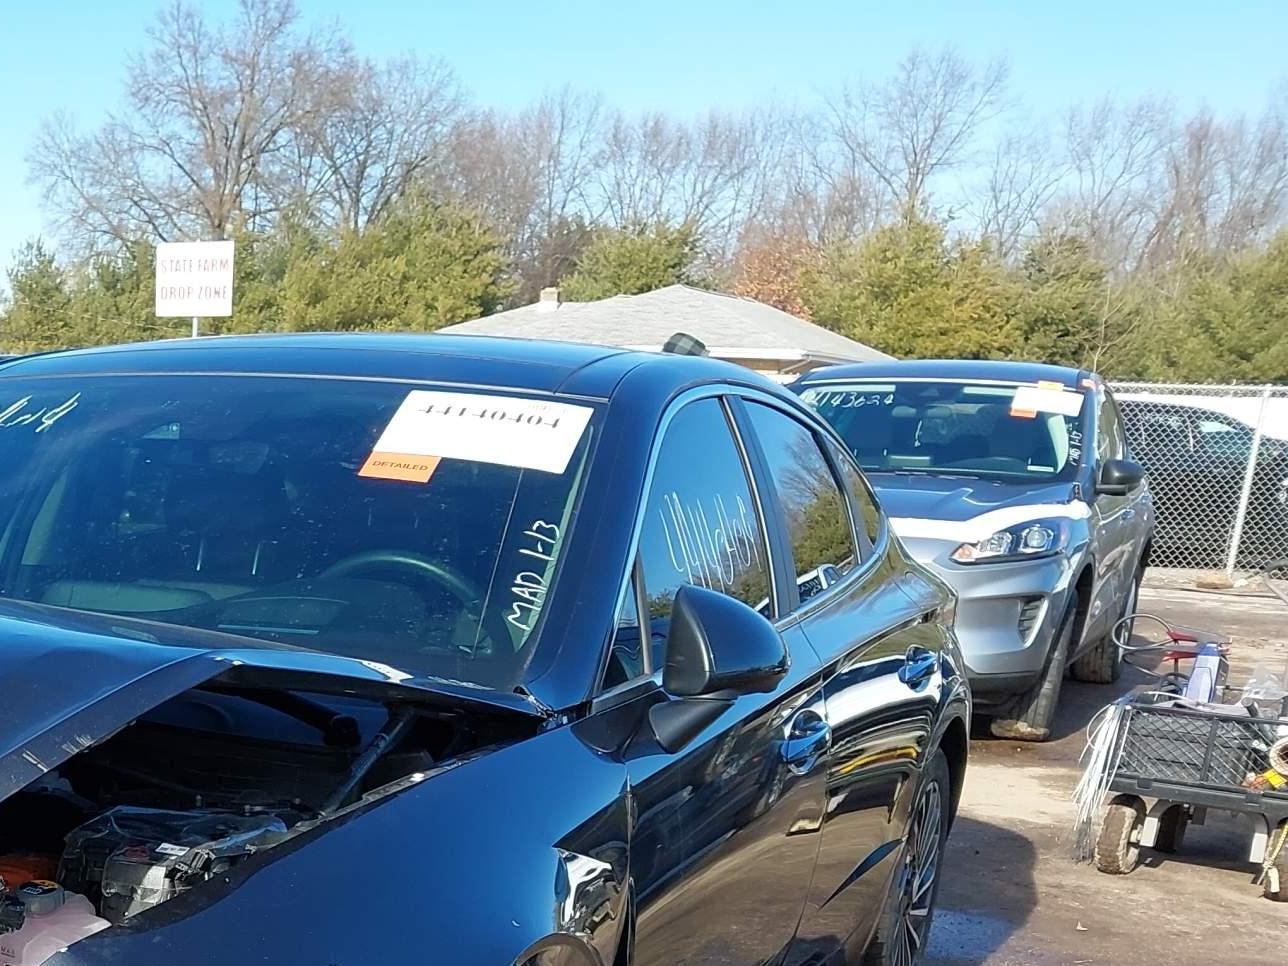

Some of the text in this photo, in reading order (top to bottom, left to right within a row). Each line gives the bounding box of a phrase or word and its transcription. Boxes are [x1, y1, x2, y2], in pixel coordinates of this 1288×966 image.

[160, 258, 230, 273] STATE FARM
[160, 286, 228, 300] DROP ZONE
[416, 404, 561, 429] 44140404
[371, 459, 430, 472] DETAILED
[507, 519, 561, 631] MAD 1-13
